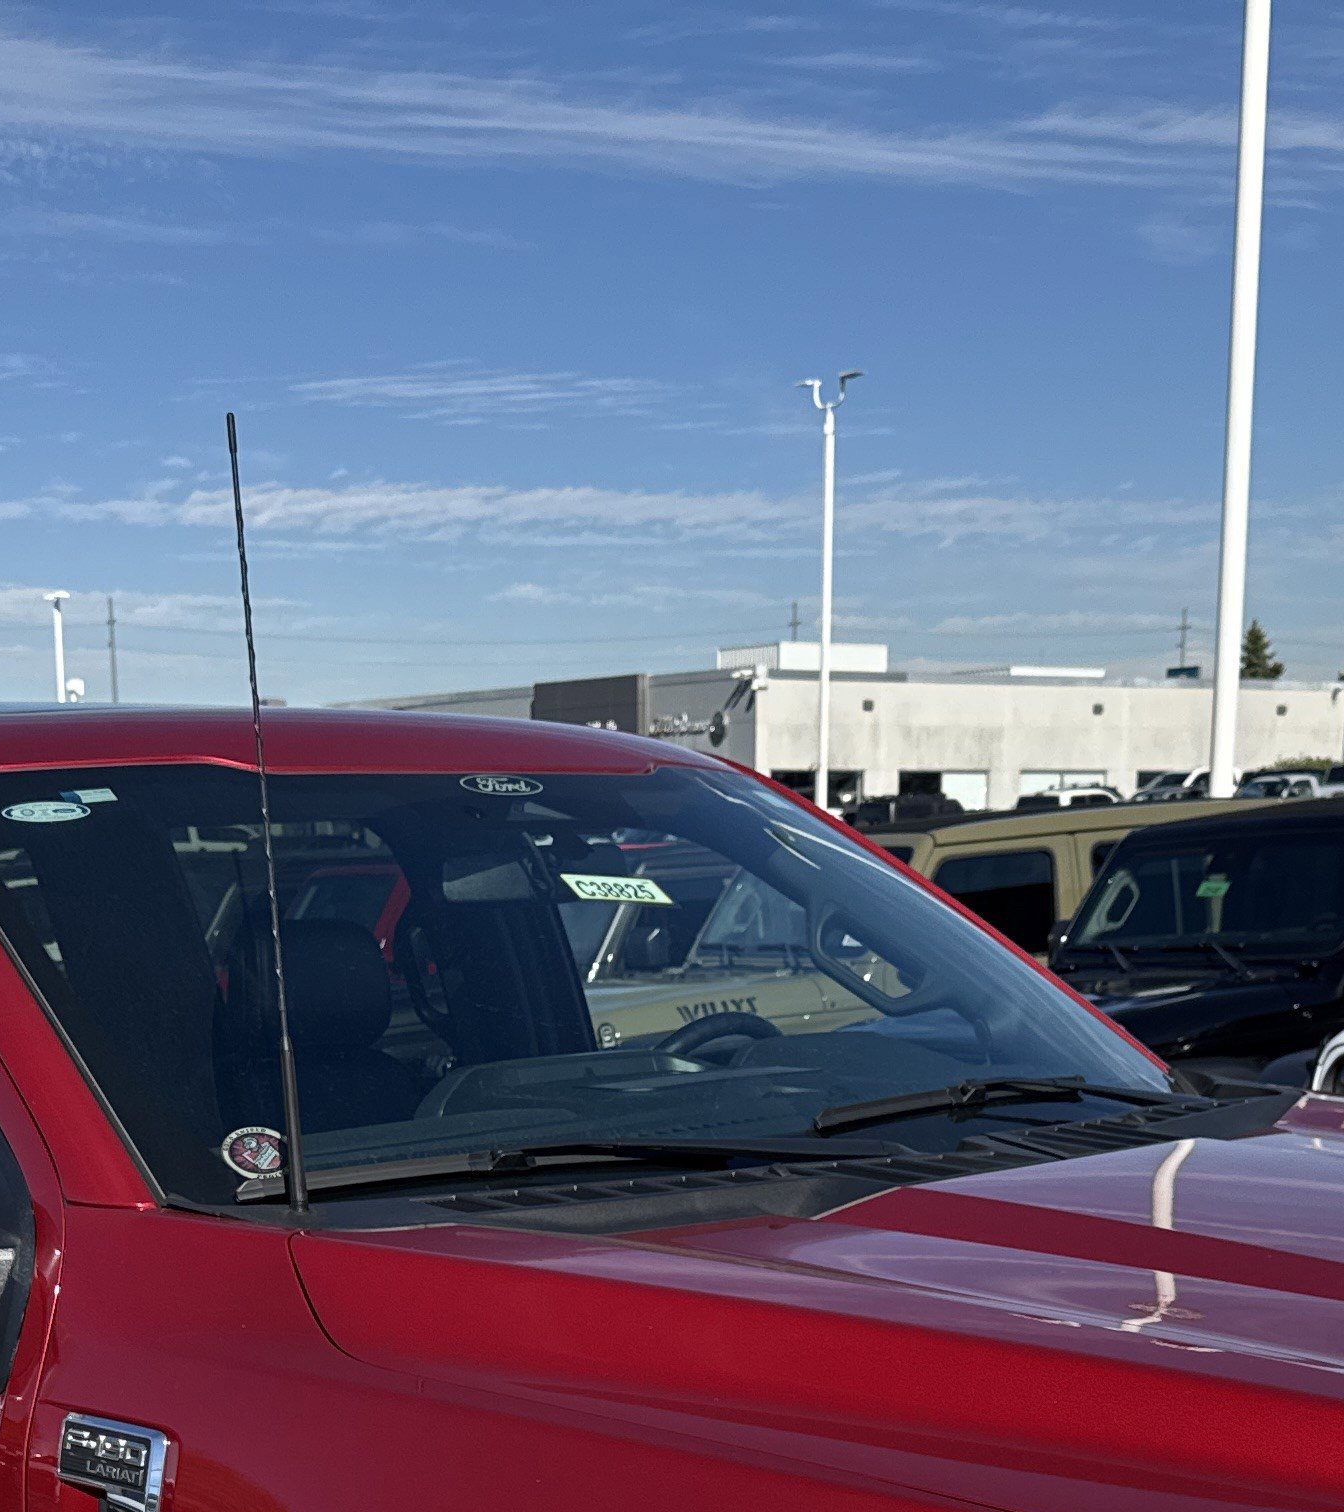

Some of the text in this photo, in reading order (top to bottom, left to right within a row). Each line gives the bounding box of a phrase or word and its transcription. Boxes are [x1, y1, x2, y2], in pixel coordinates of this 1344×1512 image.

[476, 777, 531, 793] Ford
[575, 880, 656, 900] C38825
[63, 1428, 148, 1468] F-150
[86, 1460, 145, 1487] LARIAT
